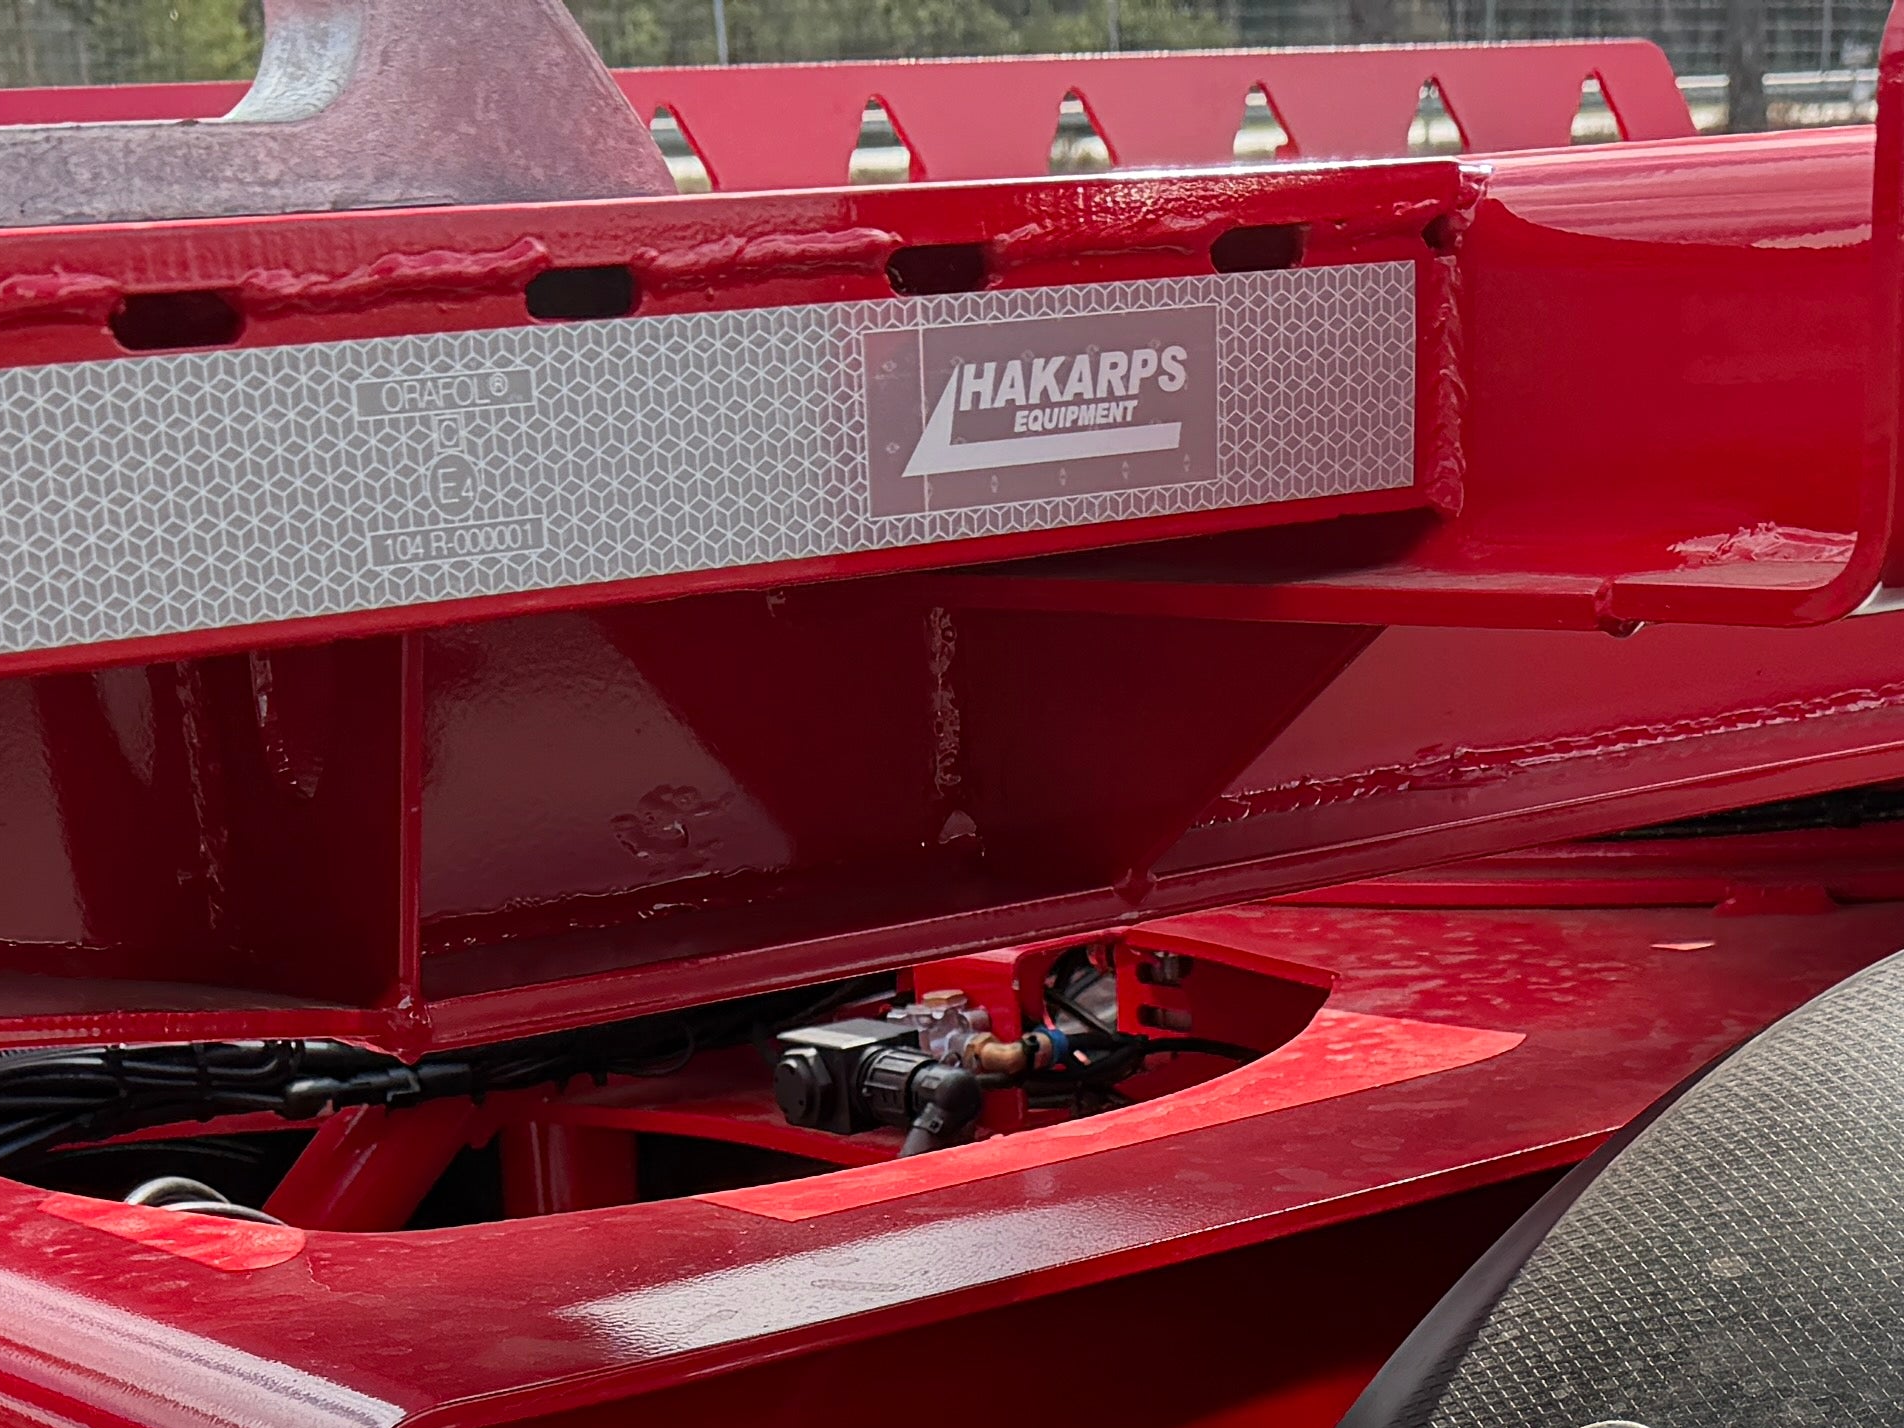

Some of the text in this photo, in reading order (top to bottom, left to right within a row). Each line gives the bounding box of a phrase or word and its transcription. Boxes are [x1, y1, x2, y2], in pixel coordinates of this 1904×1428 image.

[959, 344, 1188, 412] HAKARPS
[1013, 399, 1138, 433] EQUIPMENT
[384, 535, 424, 562] 104
